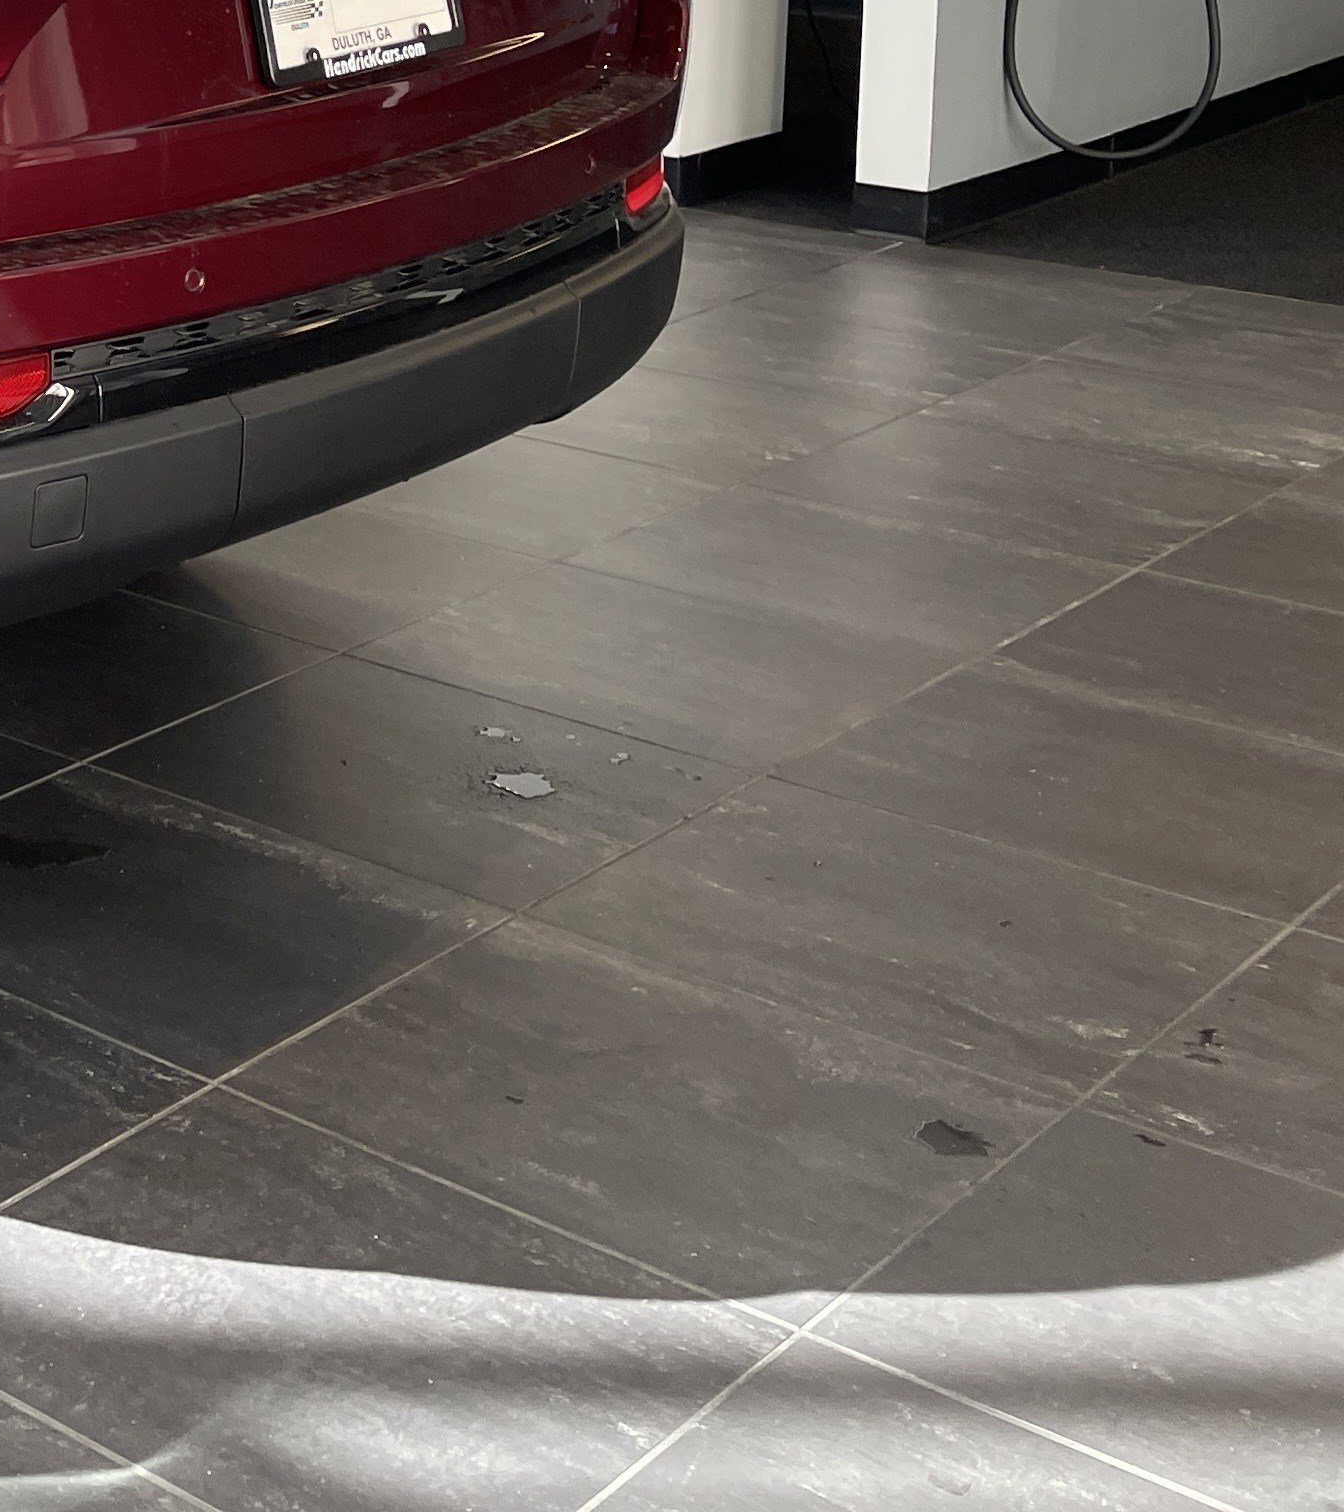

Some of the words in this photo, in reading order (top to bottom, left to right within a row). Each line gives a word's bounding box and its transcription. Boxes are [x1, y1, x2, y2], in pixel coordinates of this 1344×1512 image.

[332, 29, 375, 50] DULUTH,
[376, 26, 393, 41] GA
[324, 42, 426, 78] HendrickCars.com
